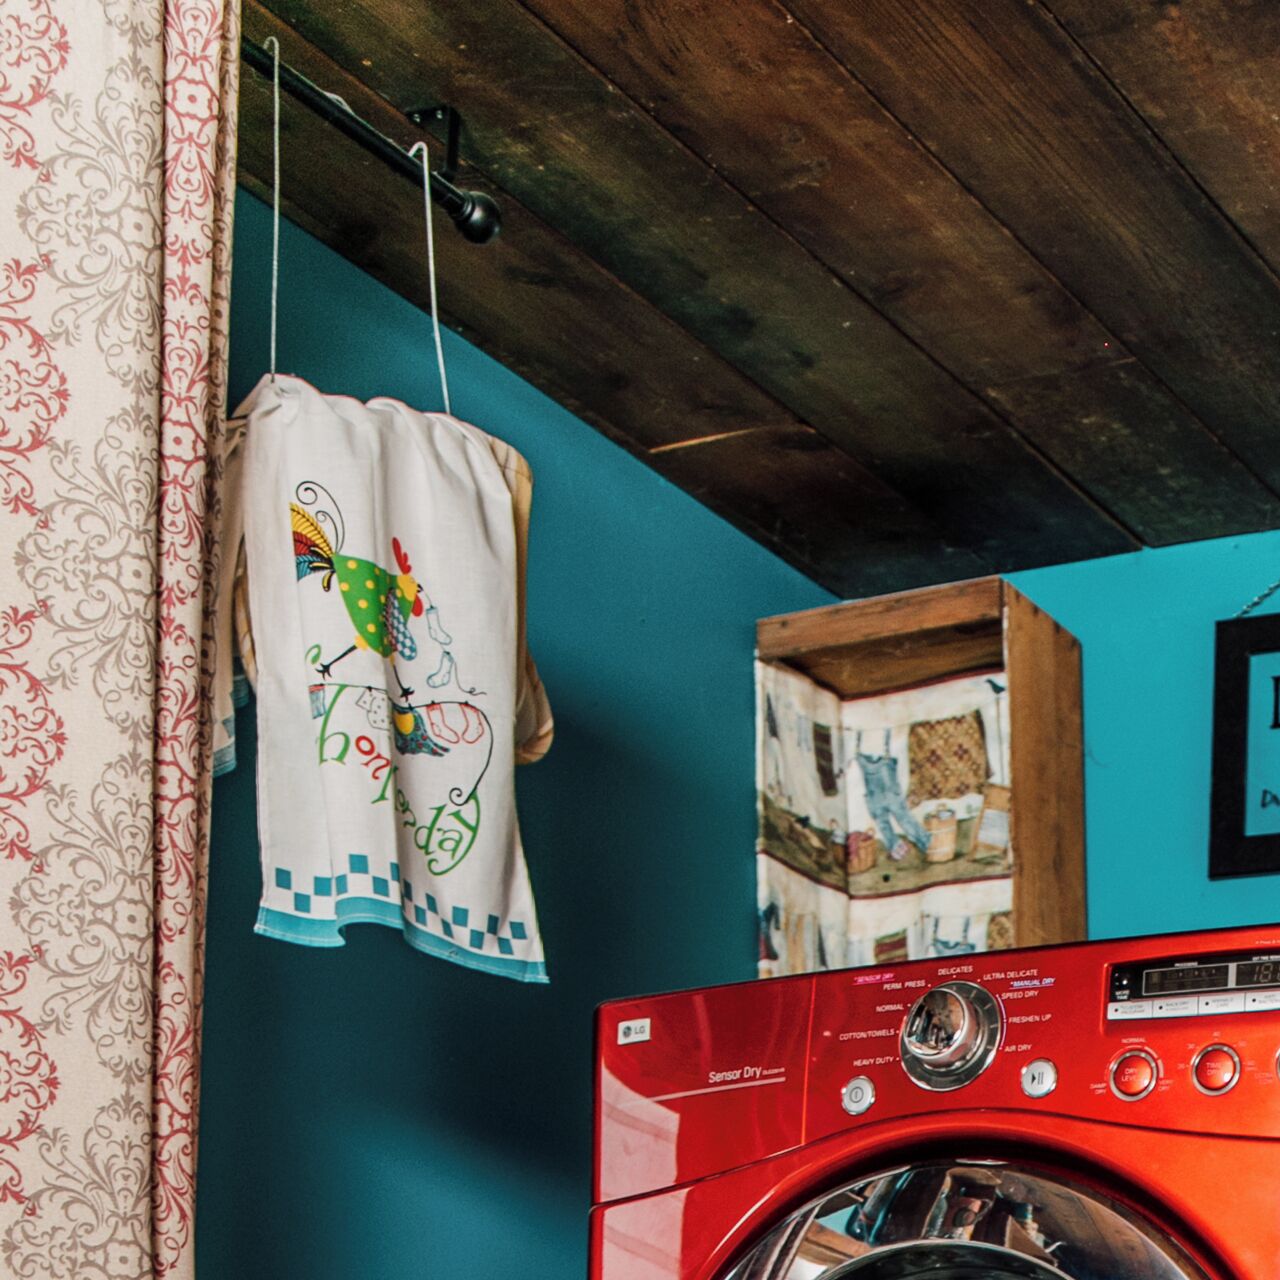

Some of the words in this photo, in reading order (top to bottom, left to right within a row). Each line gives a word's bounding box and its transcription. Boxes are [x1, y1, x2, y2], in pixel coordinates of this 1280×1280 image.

[447, 657, 491, 680] CHIPS
[938, 965, 973, 976] DELICATES
[983, 971, 1005, 981] ULTRA
[1007, 969, 1038, 979] DELICATE
[904, 980, 926, 988] PRESS
[1001, 992, 1023, 1000] SPEED
[1024, 990, 1039, 999] DRY
[876, 1004, 904, 1012] NORMAL
[1008, 1015, 1040, 1023] FRESHEN
[1042, 1014, 1052, 1022] UP
[839, 1028, 895, 1041] COTTON/TOWELS
[853, 1058, 875, 1067] HEAVY
[875, 1056, 894, 1065] DUTY
[708, 1067, 742, 1083] Sensor
[744, 1066, 761, 1079] Dry
